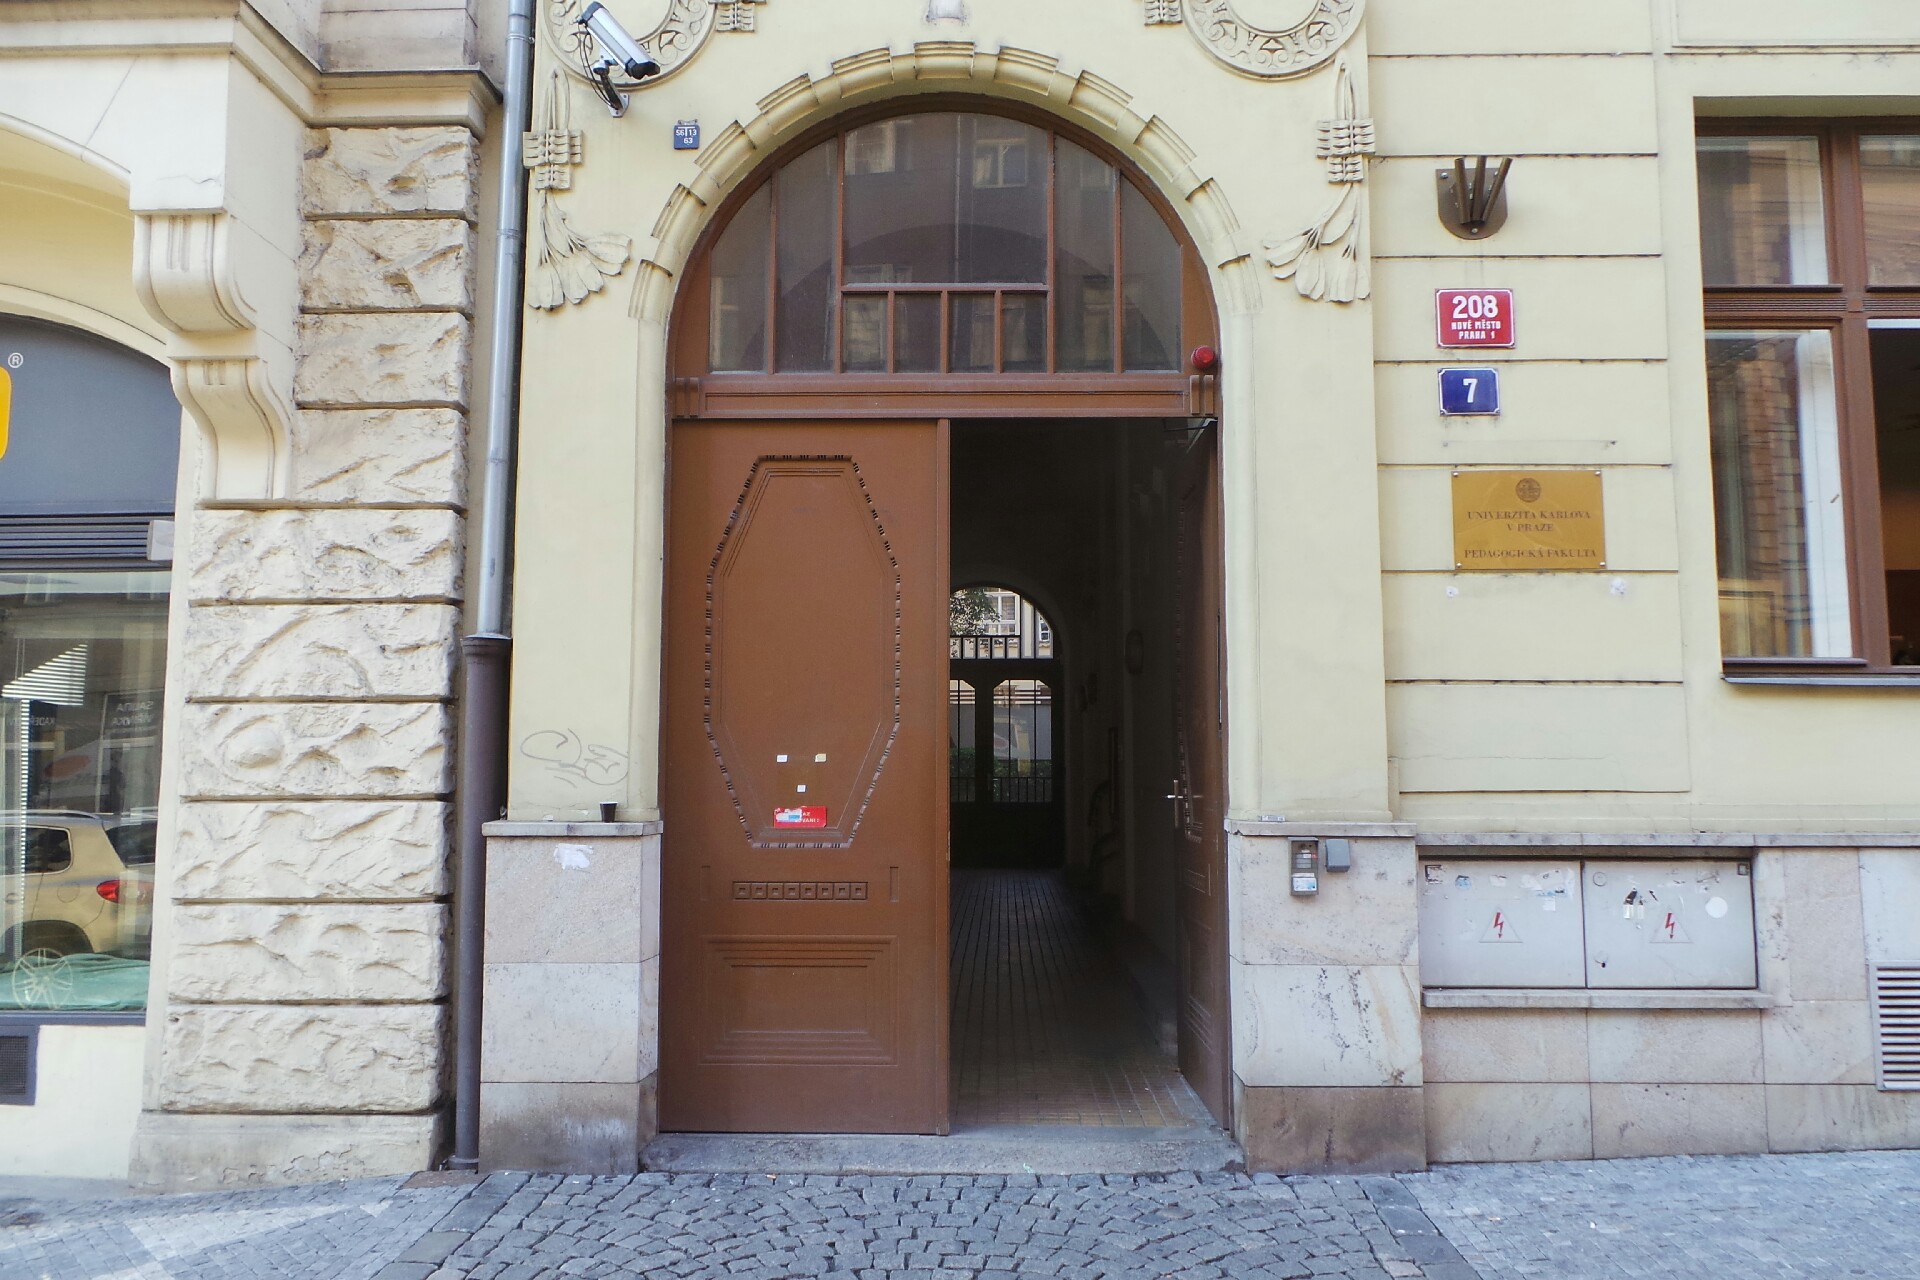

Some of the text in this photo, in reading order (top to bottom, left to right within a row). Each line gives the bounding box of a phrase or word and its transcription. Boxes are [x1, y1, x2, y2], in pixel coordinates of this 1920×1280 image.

[1452, 294, 1499, 319] 208
[1458, 331, 1496, 340] PRAHA 1
[1462, 378, 1478, 403] 7
[1467, 510, 1591, 520] UNIVERZITA KARLOVA
[1506, 523, 1554, 532] V PRAZE
[1464, 547, 1597, 558] PEDAGOGICKÁ FAKULTA
